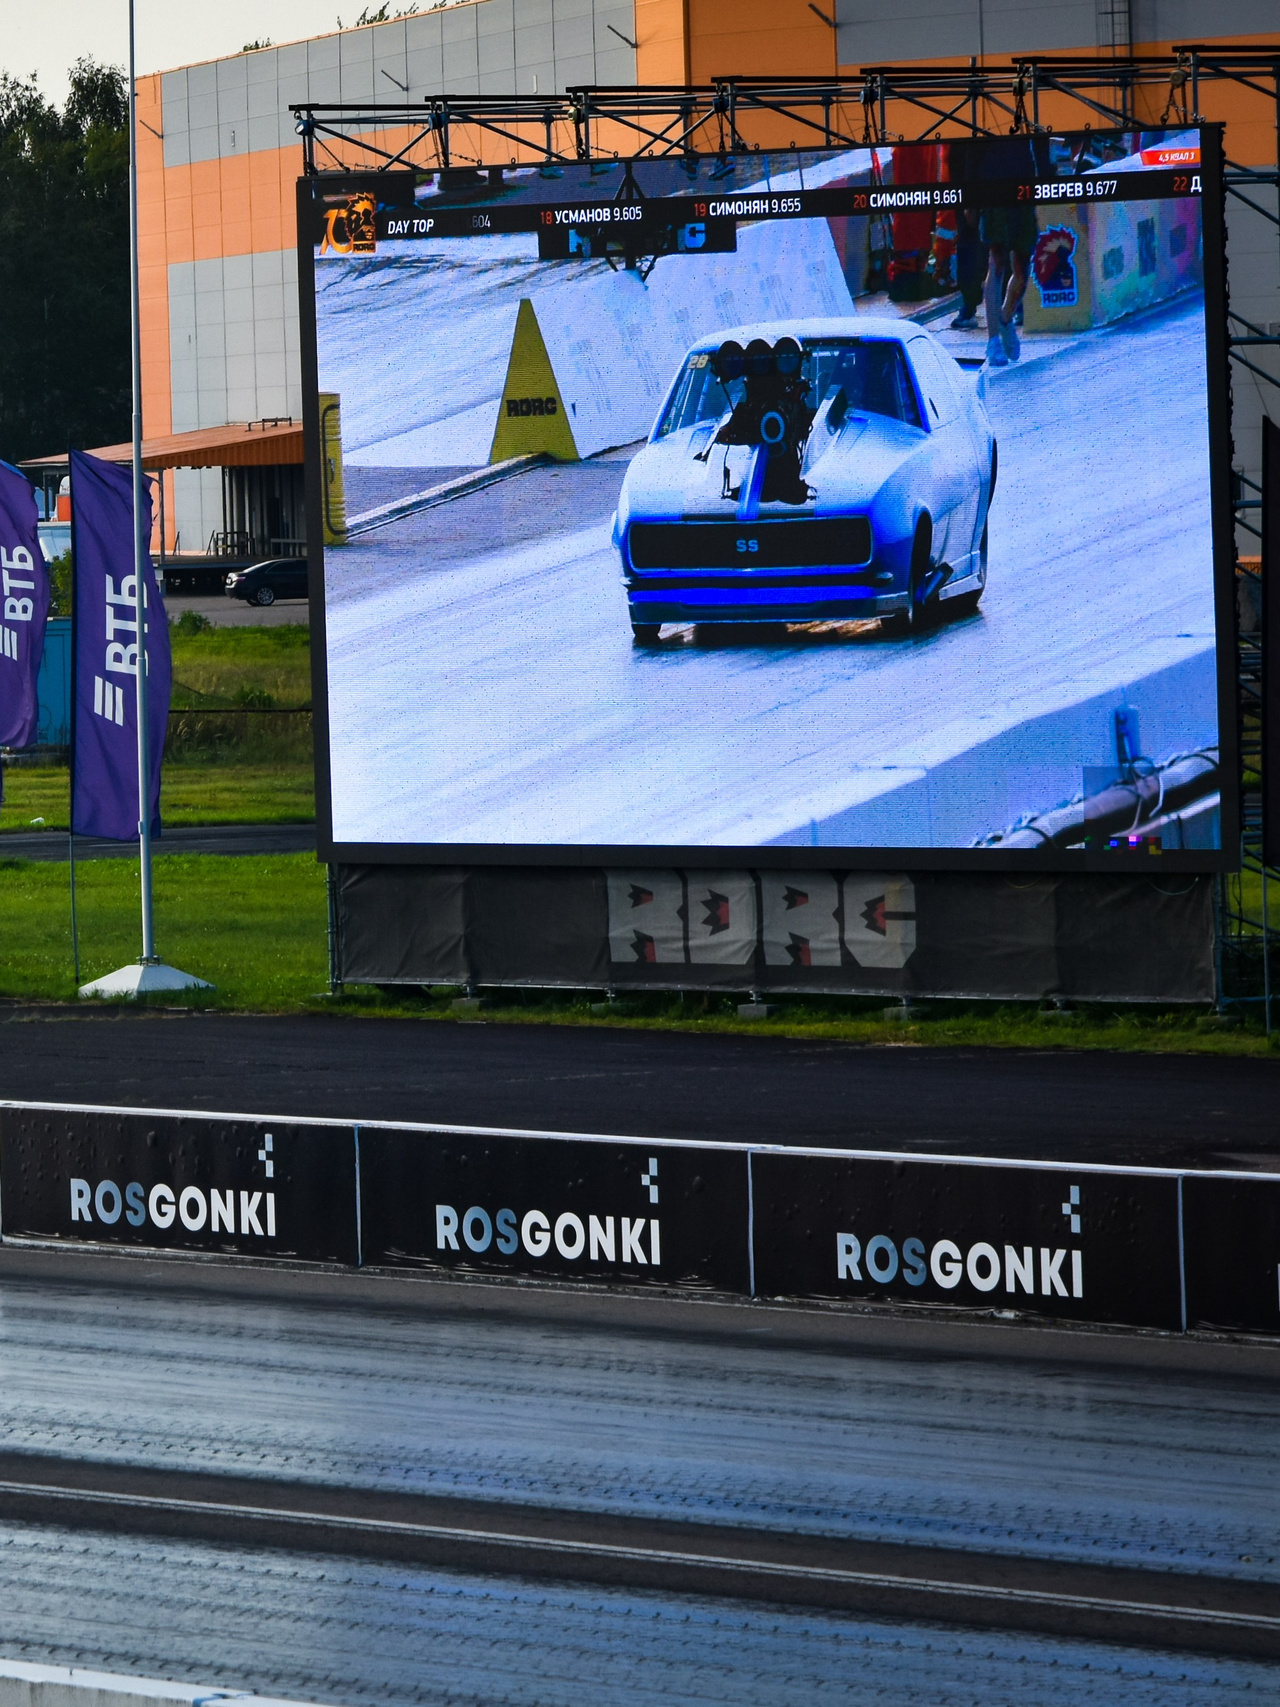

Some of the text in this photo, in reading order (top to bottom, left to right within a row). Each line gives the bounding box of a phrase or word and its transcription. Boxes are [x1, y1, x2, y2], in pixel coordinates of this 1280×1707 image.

[1017, 180, 1117, 199] 21 ЗВЕРЕВ 9.677
[1173, 176, 1188, 191] 22
[694, 198, 801, 217] 19 СИМОНЯН 9.655
[853, 189, 963, 208] 20 СИМОНЯН 9.661
[540, 206, 642, 225] 18 УСМАНОВ 9.605
[388, 220, 410, 235] DAY
[413, 218, 434, 232] TOP
[687, 354, 710, 369] 28
[736, 539, 759, 553] SS
[0, 545, 35, 621] ВТБ
[105, 573, 148, 676] ВТБ
[70, 1177, 276, 1237] ROSGONKI
[435, 1204, 661, 1266] ROSGONKI
[837, 1232, 1083, 1298] ROSGONKI
